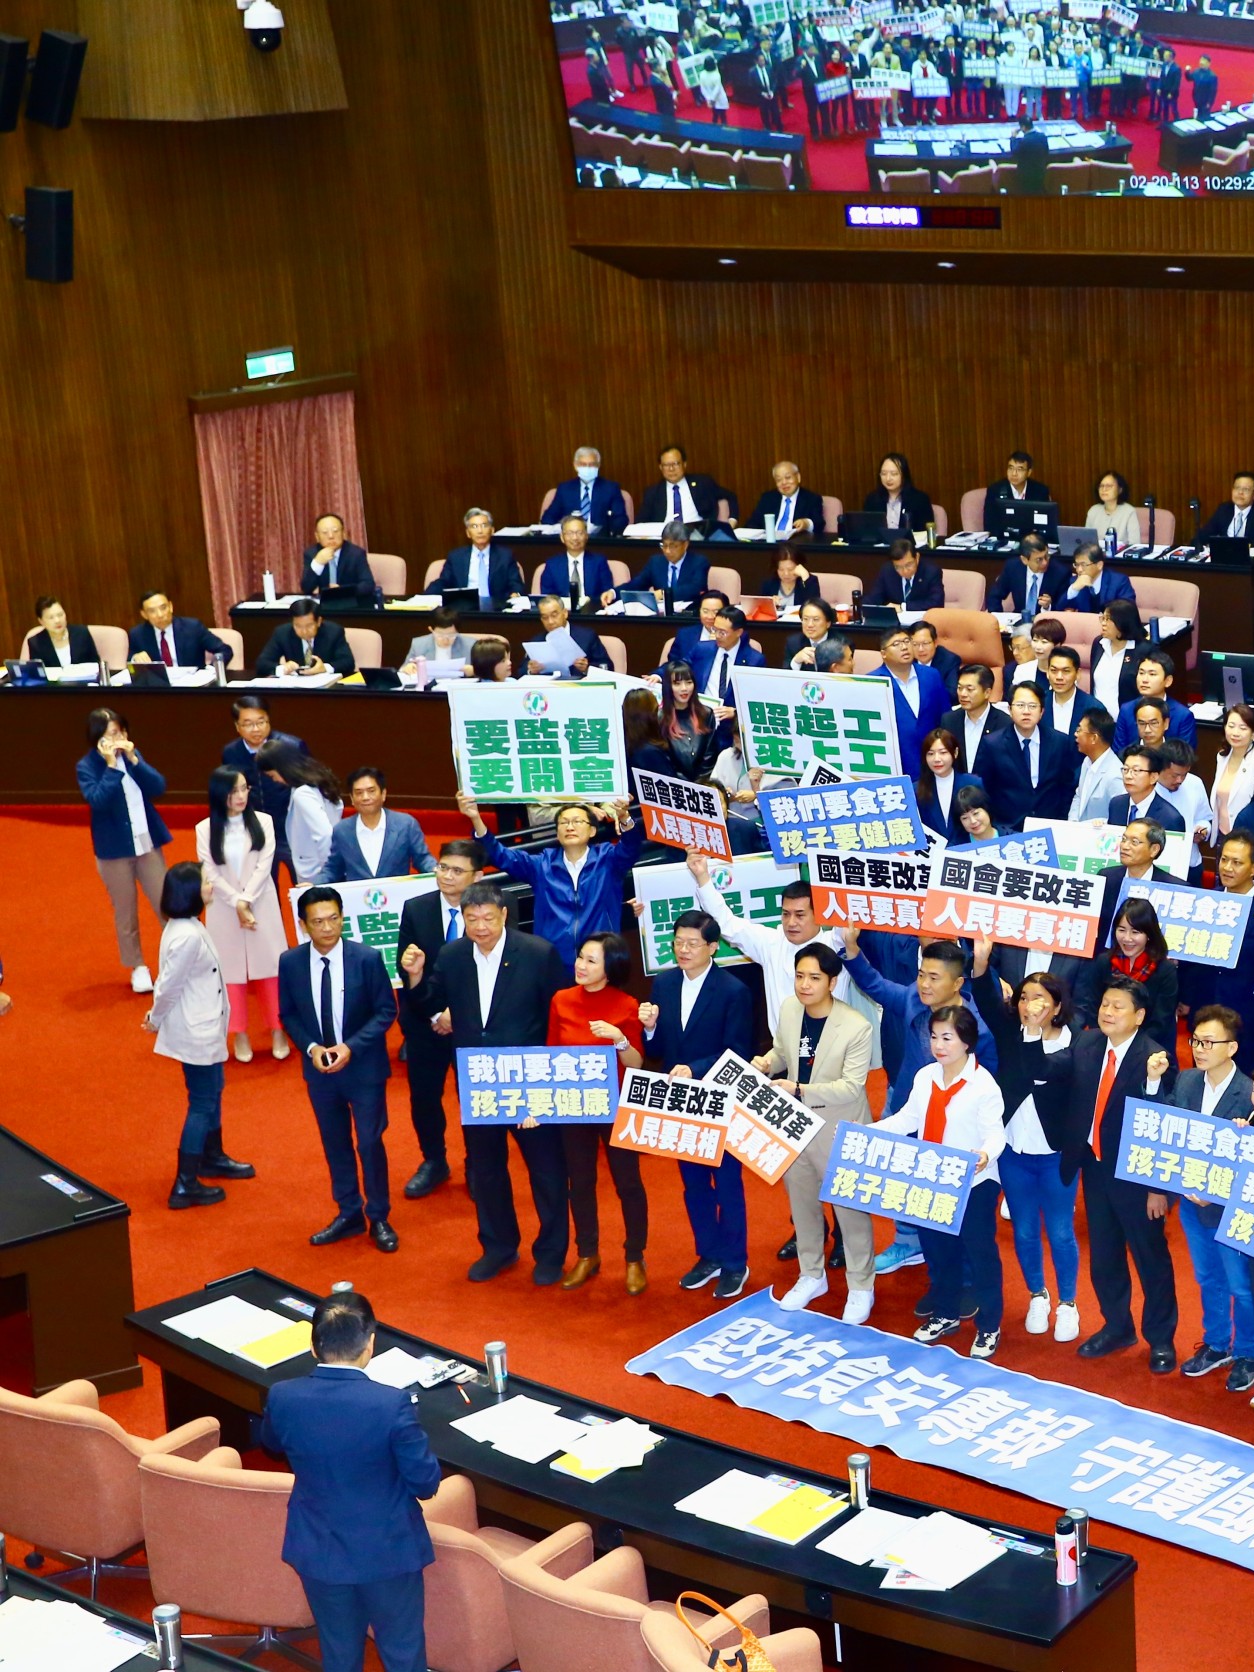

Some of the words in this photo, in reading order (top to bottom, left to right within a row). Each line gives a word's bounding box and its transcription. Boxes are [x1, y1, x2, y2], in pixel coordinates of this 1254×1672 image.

[464, 717, 611, 756] 要監督
[747, 700, 887, 741] 照起工
[468, 756, 615, 794] 要開會
[752, 735, 892, 775] 來上工
[638, 774, 719, 820] 國會要改革
[768, 784, 907, 825] 我們要食安
[649, 813, 727, 855] 人民要真相
[778, 817, 917, 858] 孩子要健康
[940, 855, 1095, 909] 國會要改革
[822, 891, 926, 928] 人民要真
[933, 896, 1090, 951] 人民要真相
[1159, 922, 1235, 961] 要健康
[467, 1052, 609, 1084] 我們要食安
[470, 1087, 611, 1118] 孩子要健康
[626, 1074, 729, 1121] 國會要改革
[712, 1058, 814, 1141] 國會要改革
[617, 1113, 721, 1160] 人民要真相
[841, 1130, 968, 1189] 我們要食安
[830, 1166, 960, 1227] 孩子要健康
[671, 1316, 1094, 1470] 堅持食安專報
